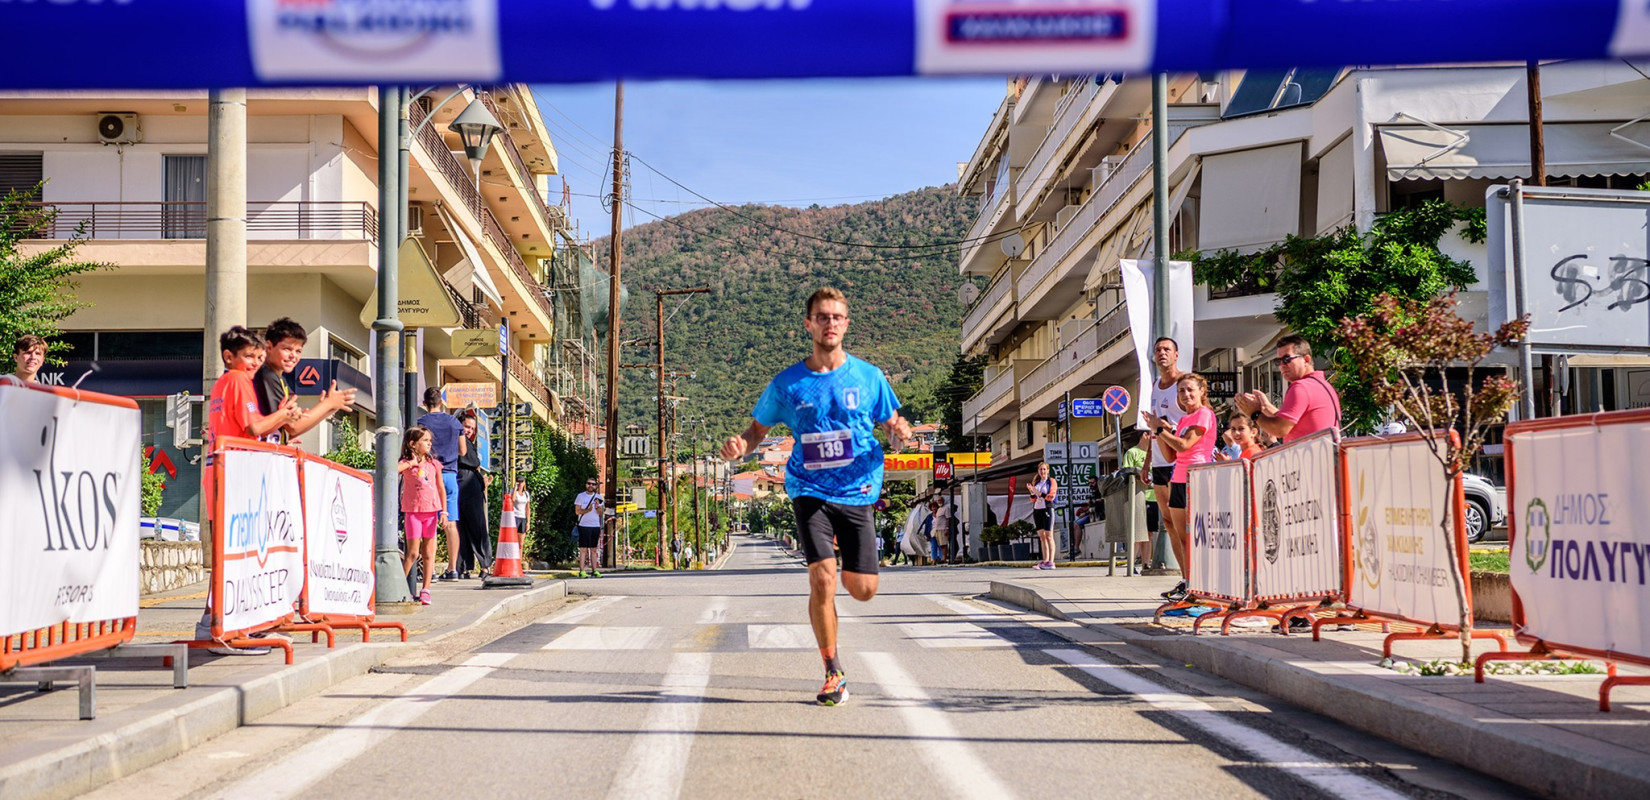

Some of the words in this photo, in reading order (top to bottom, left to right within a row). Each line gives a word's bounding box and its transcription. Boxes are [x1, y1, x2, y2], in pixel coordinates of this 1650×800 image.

[817, 440, 845, 459] 139
[884, 457, 930, 470] Shell
[1052, 464, 1093, 475] HOME
[936, 464, 950, 477] illy
[1553, 493, 1611, 525] ΔΗΜΟΣ
